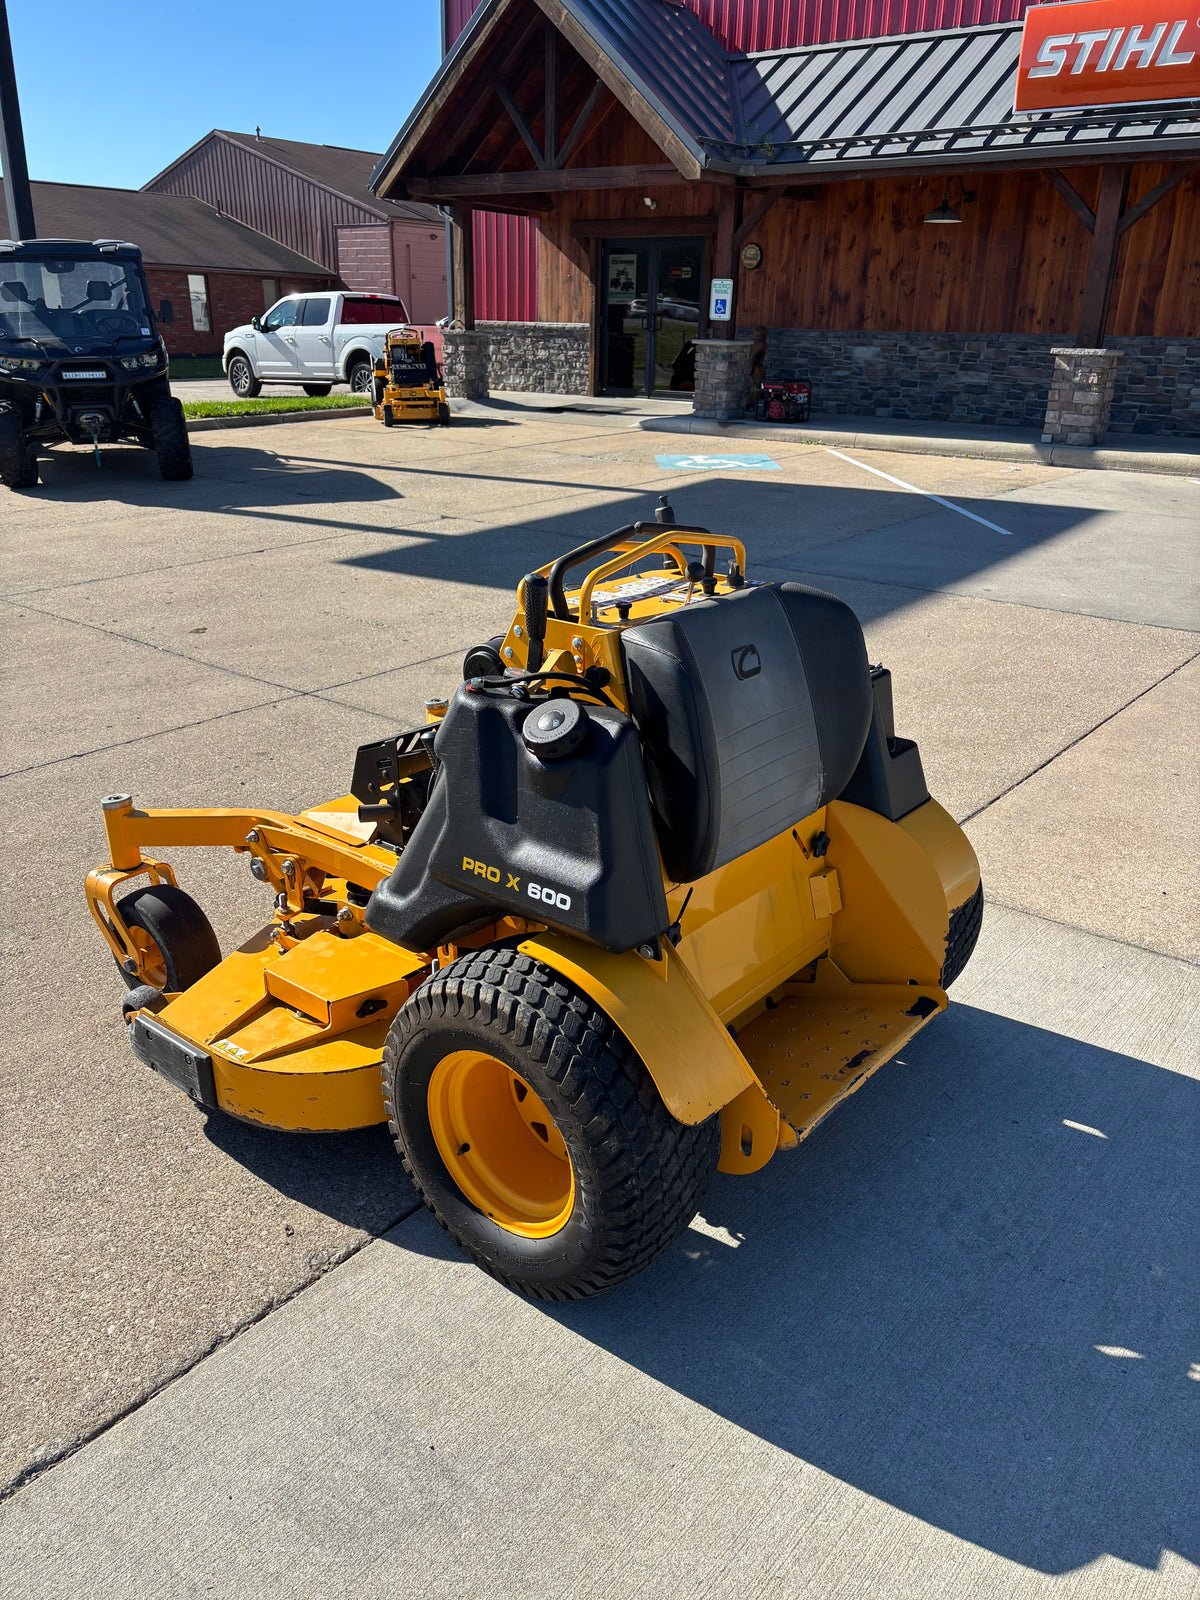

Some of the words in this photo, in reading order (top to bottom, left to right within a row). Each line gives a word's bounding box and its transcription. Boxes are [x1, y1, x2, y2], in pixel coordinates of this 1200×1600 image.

[1027, 20, 1195, 79] STIHL
[462, 857, 500, 883] PRO
[505, 873, 520, 892] X
[527, 882, 571, 911] 600
